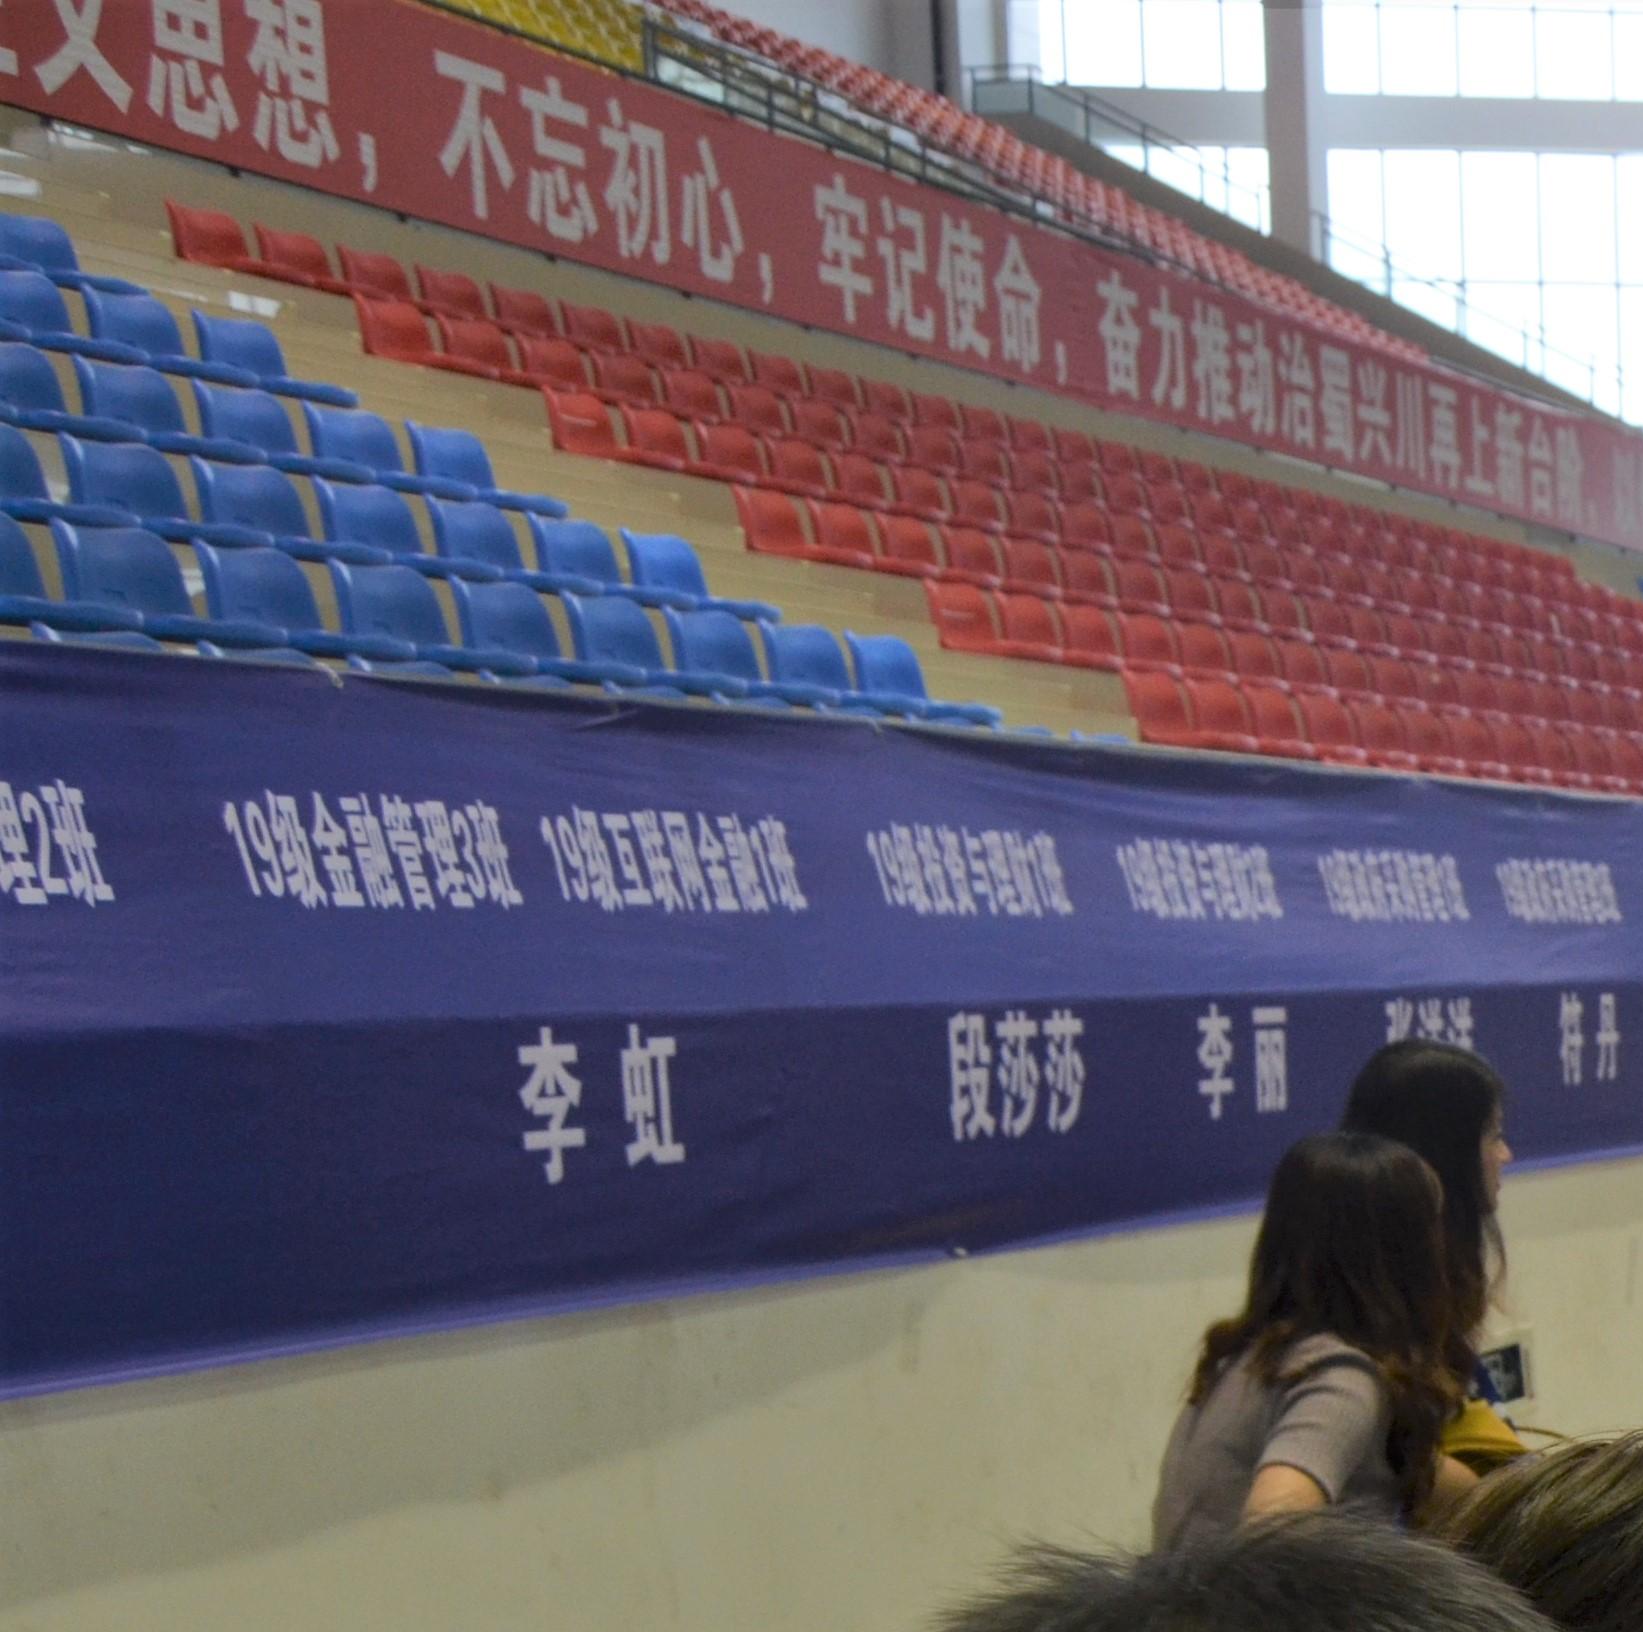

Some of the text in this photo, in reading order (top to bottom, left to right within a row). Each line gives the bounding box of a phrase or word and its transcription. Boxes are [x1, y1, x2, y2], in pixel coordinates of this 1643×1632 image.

[222, 788, 524, 911] 19级金融管理3班
[540, 804, 808, 914] 19级互联网金融1班
[947, 1009, 1086, 1141] 段莎莎
